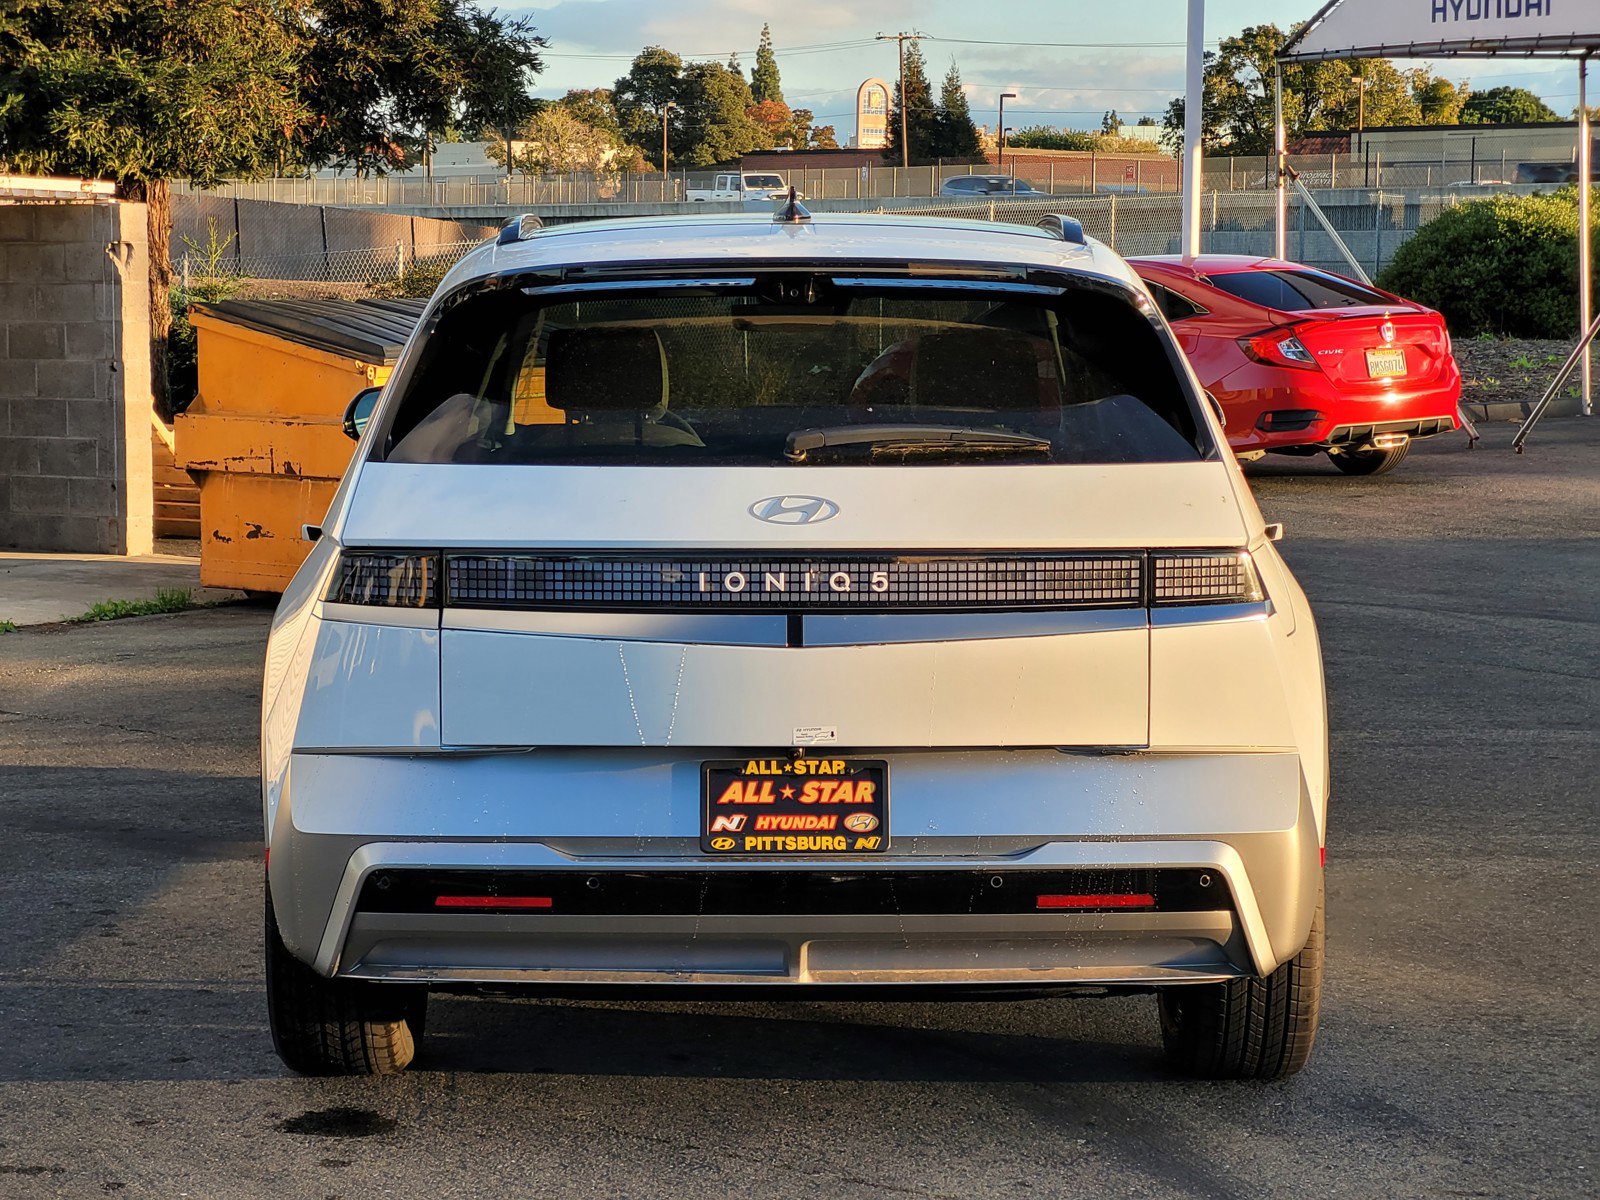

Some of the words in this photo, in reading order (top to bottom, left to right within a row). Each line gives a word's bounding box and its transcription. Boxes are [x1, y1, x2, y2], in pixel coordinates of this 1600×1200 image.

[1431, 0, 1550, 23] HYUNDAI
[745, 760, 782, 775] ALL
[793, 760, 846, 775] STAR
[717, 780, 776, 804] ALL
[798, 780, 876, 804] STAR
[753, 814, 839, 831] HYUNDAI
[744, 835, 847, 851] PITTSBURG
